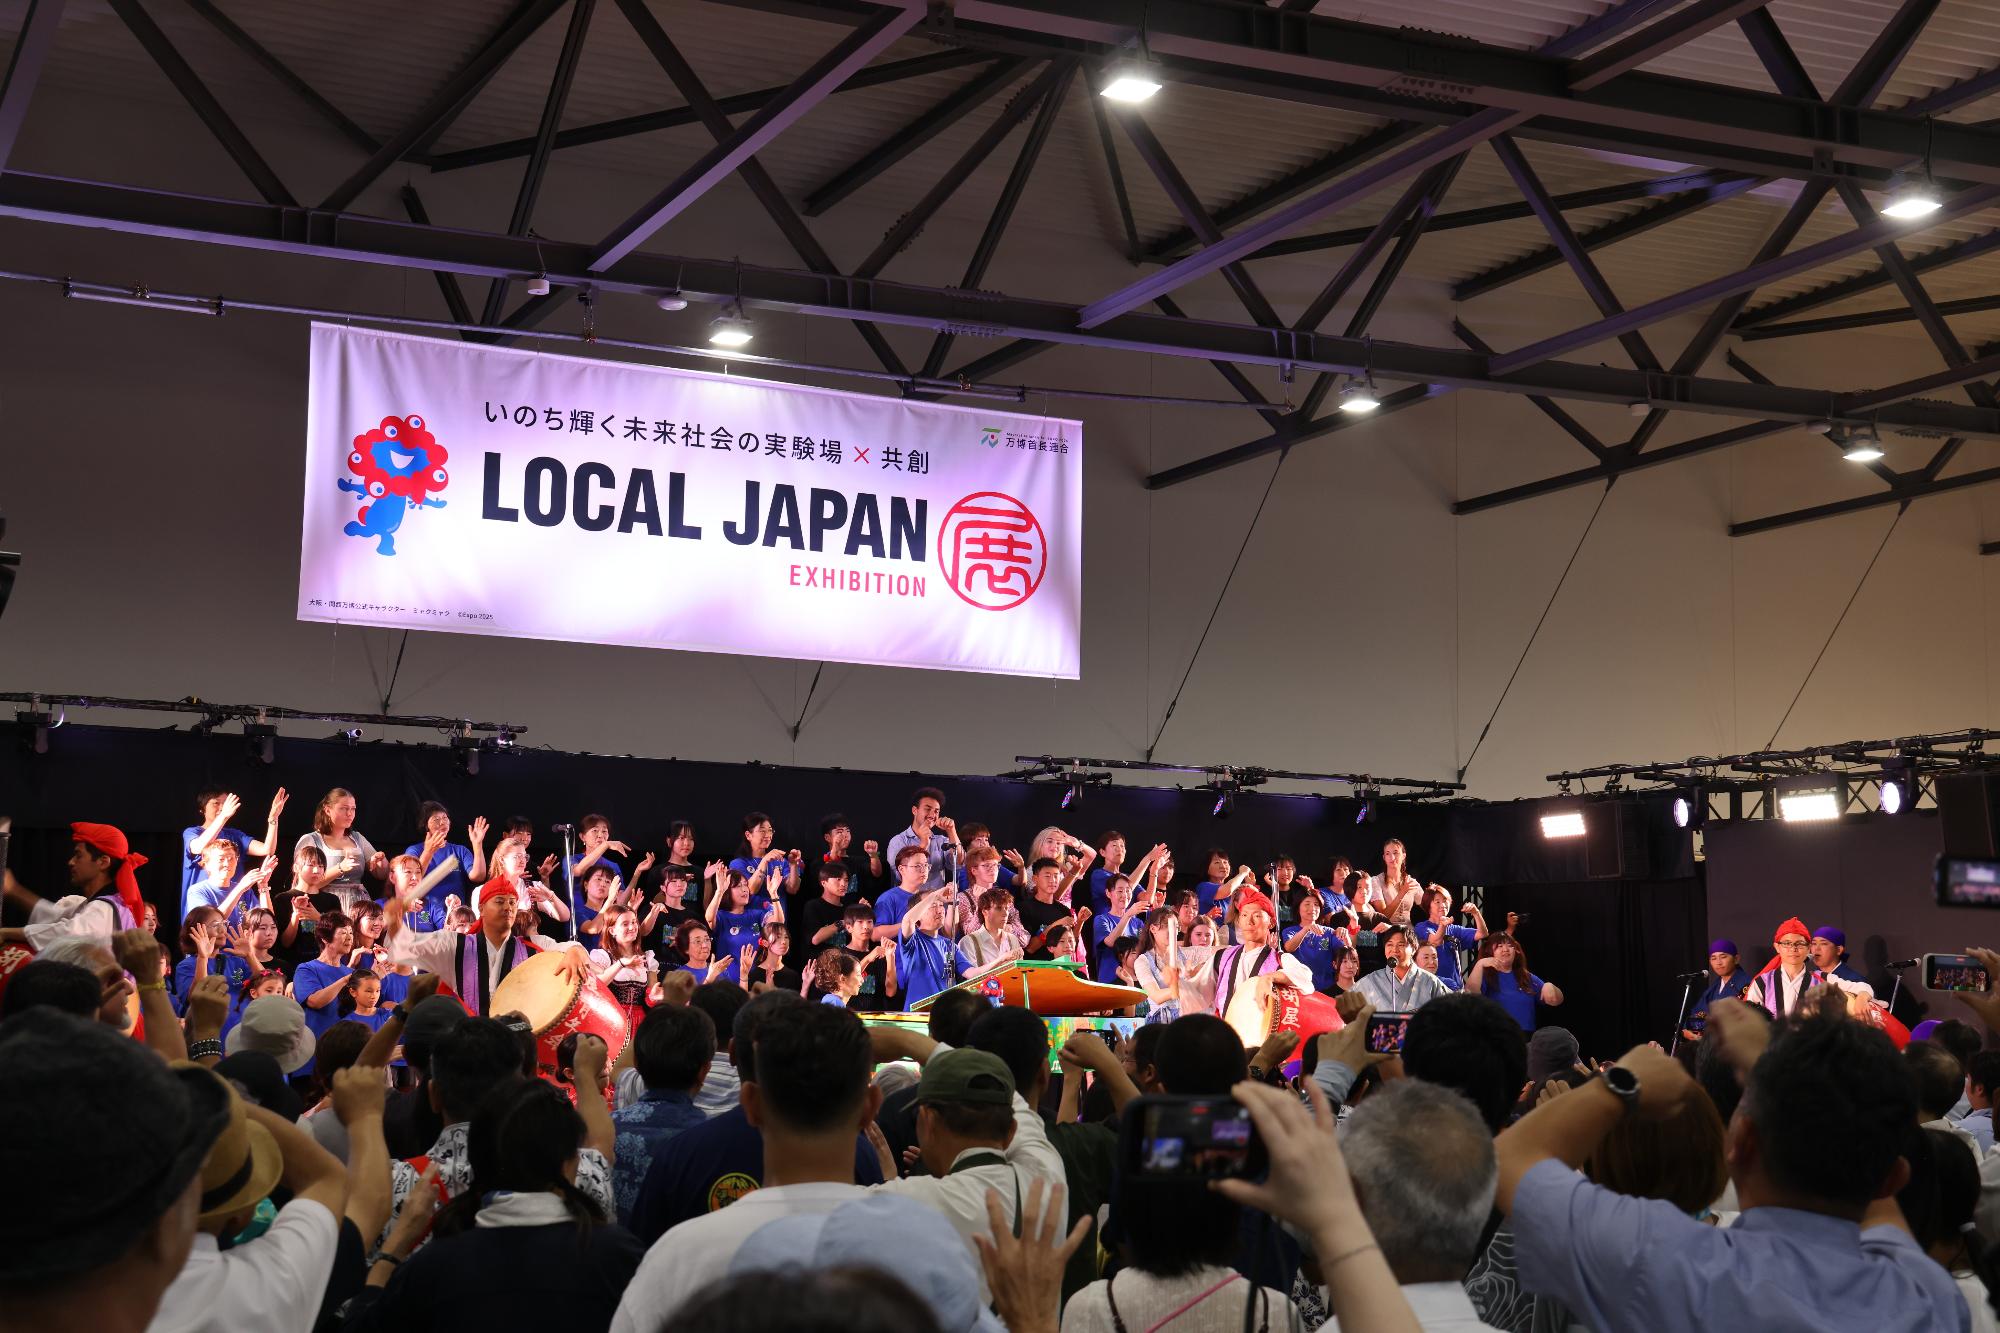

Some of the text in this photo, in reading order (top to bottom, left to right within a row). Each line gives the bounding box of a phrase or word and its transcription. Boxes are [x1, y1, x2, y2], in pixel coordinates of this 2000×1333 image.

[485, 401, 842, 465] いのち輝く未来社会の実験場
[881, 446, 930, 475] 共創
[1005, 437, 1069, 454] 万博首長連合
[482, 452, 928, 562] LOCAL JAPAN
[789, 564, 926, 598] EXHIBITION
[1280, 986, 1301, 1031] 胡屋
